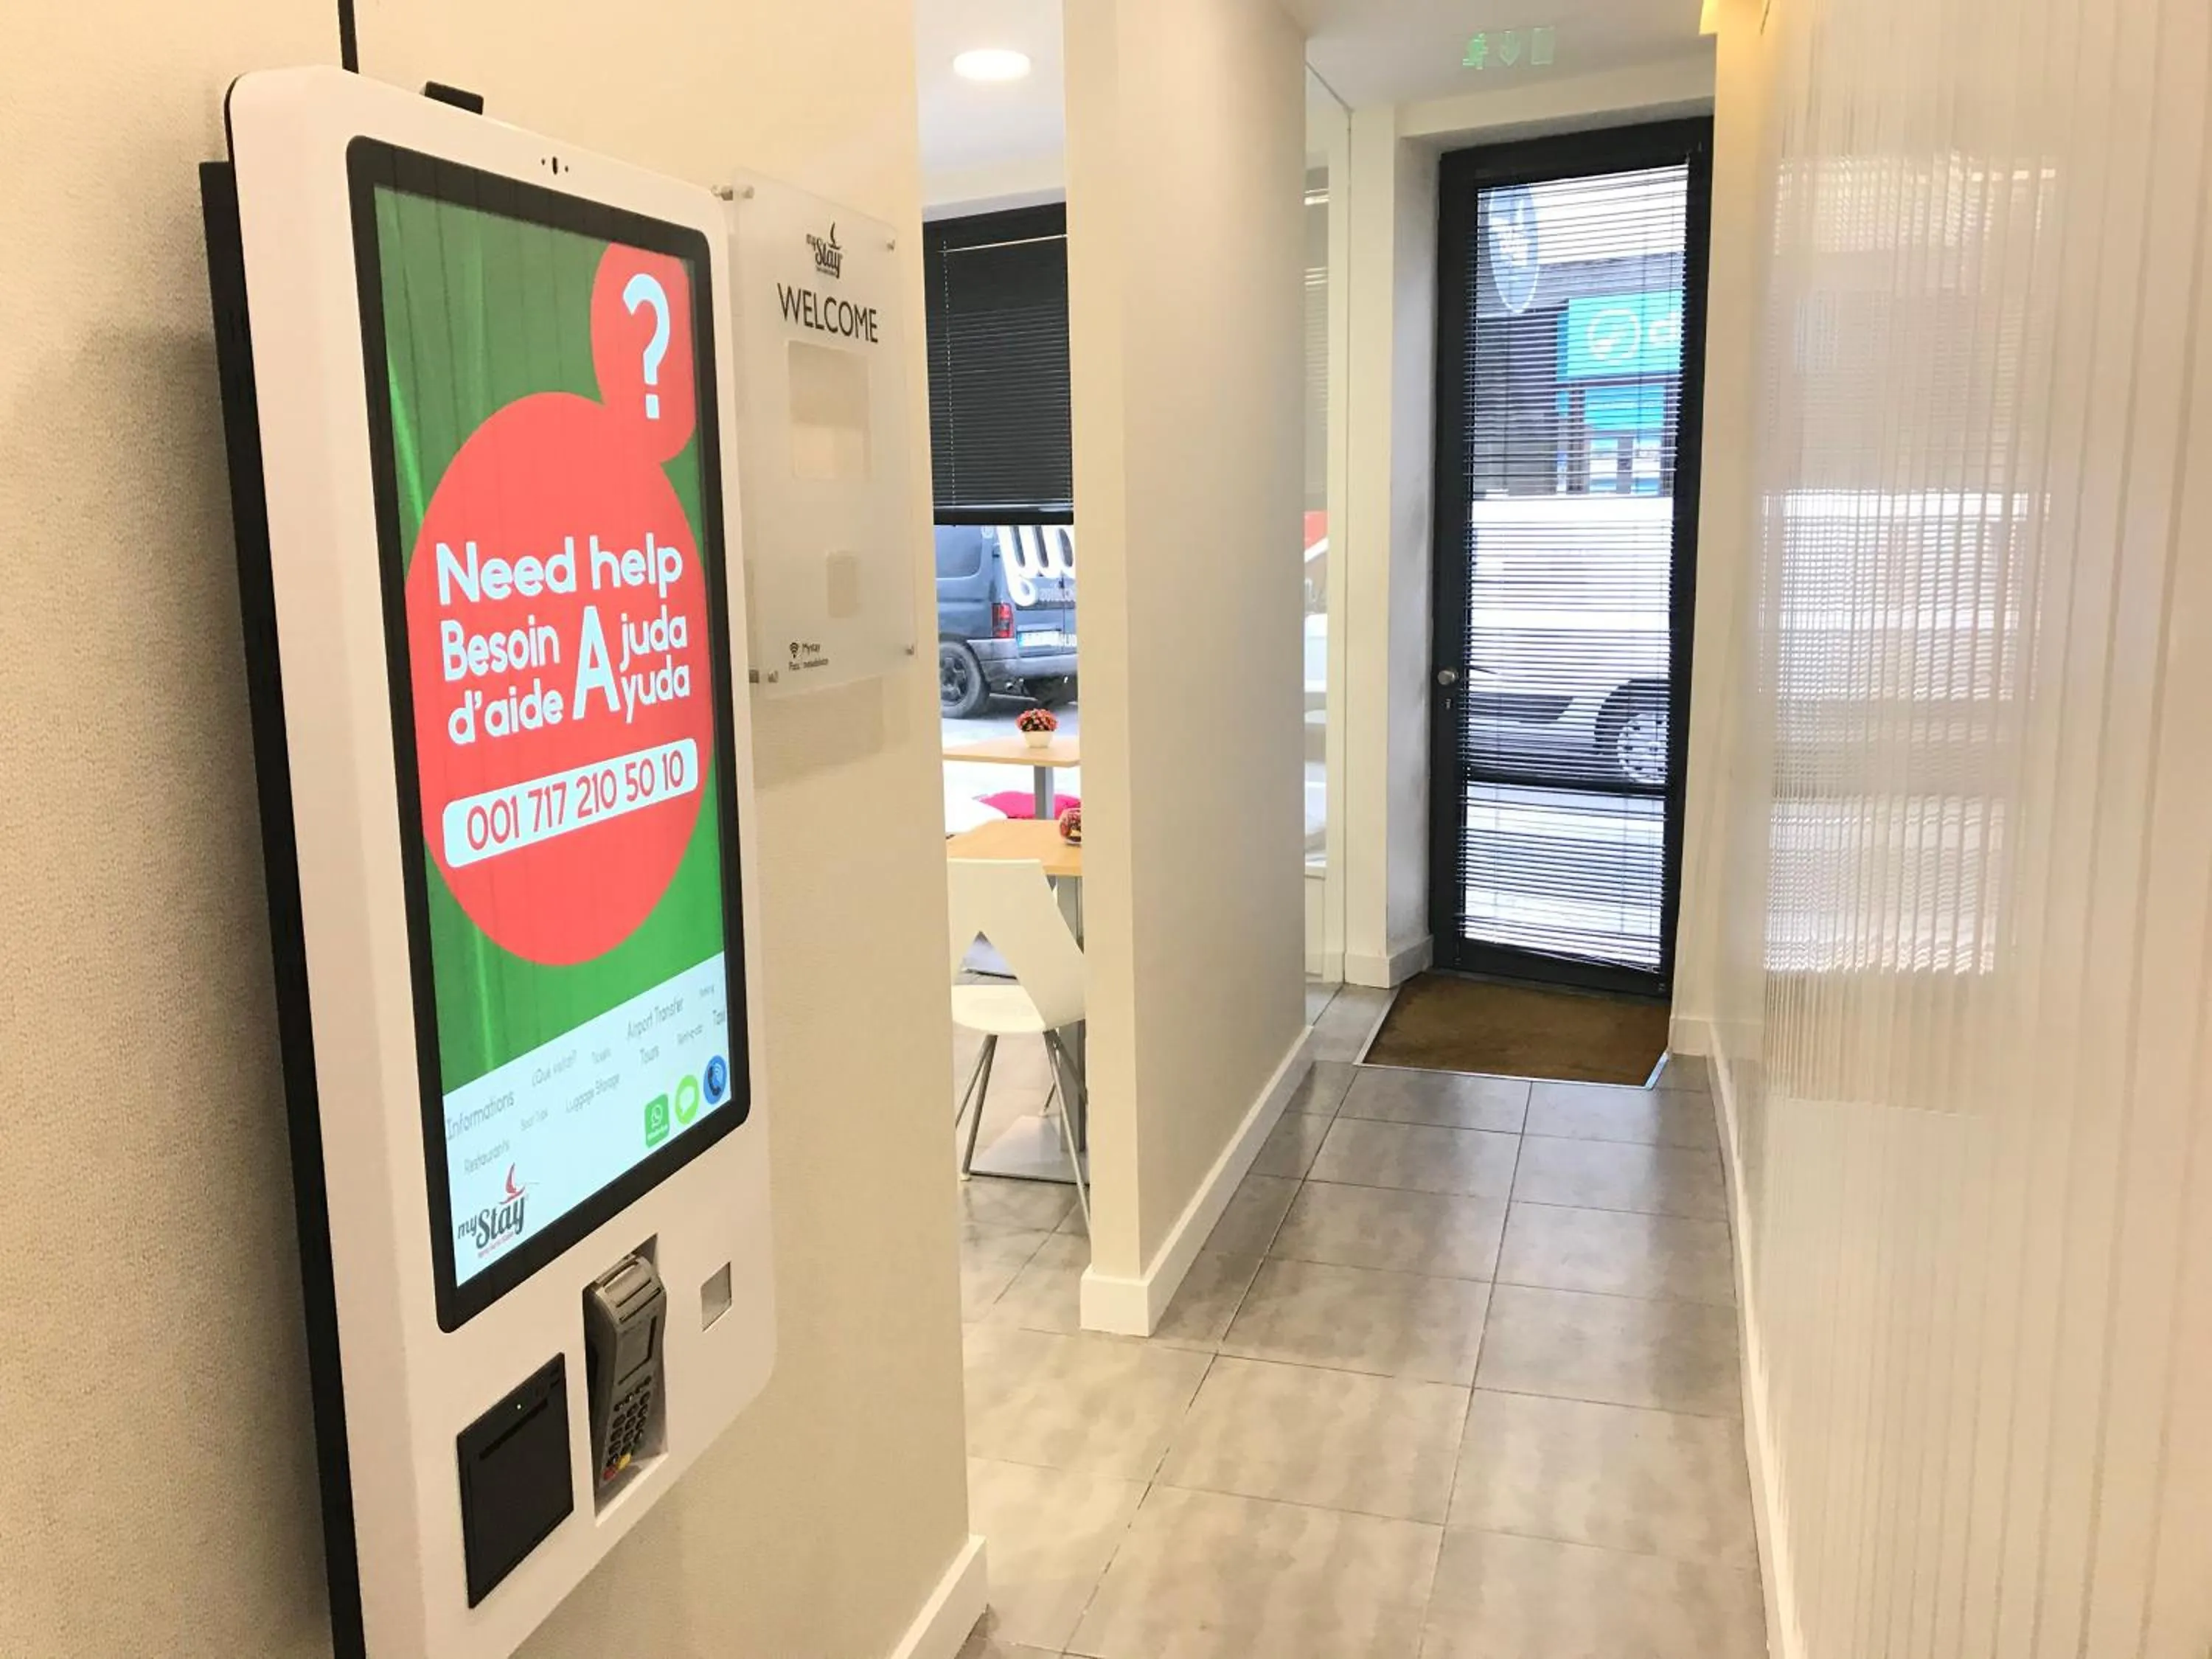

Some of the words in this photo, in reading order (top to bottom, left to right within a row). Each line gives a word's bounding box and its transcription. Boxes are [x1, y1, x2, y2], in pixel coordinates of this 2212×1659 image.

[623, 274, 669, 419] ?
[777, 282, 879, 344] WELCOME
[436, 536, 577, 605] Need
[590, 532, 684, 599] help
[440, 614, 560, 682] Besoin
[448, 678, 564, 745] d'aide
[466, 795, 521, 851] 001
[528, 782, 567, 833] 717
[576, 769, 618, 819] 210
[625, 759, 655, 802] 50
[662, 750, 684, 791] 10
[447, 1091, 515, 1141] Informations
